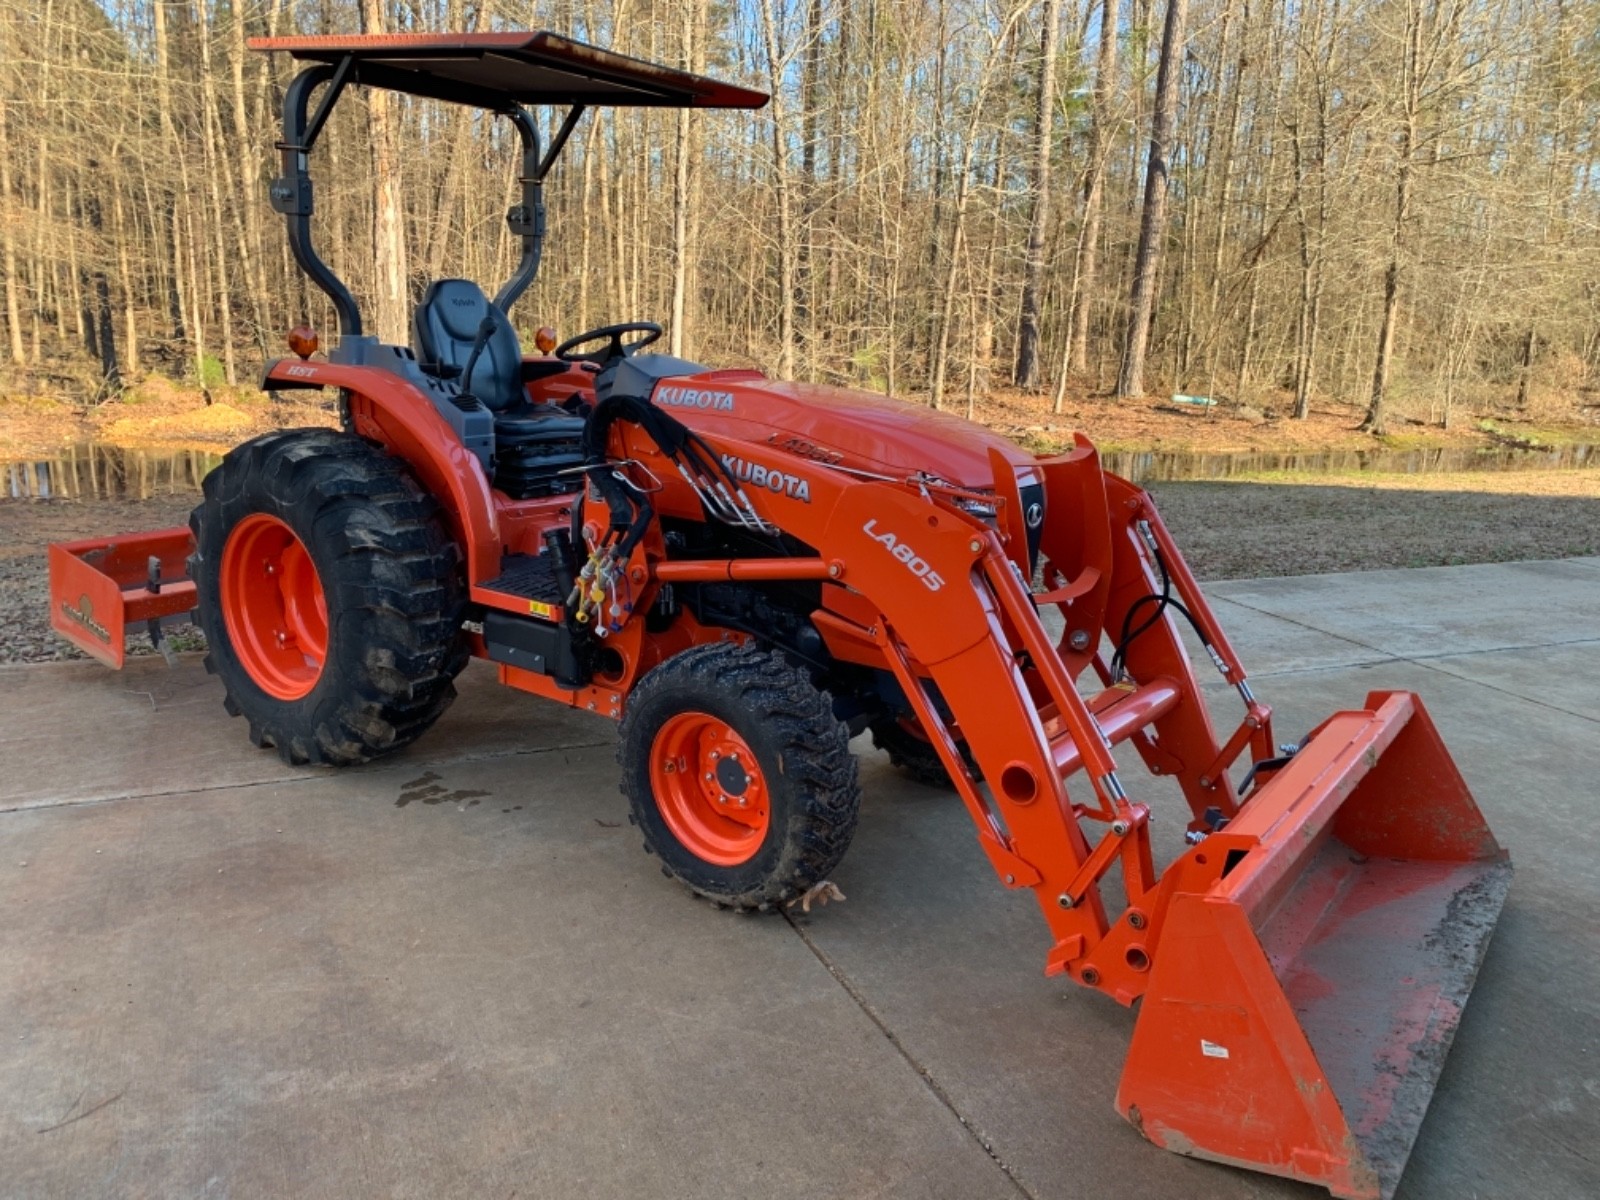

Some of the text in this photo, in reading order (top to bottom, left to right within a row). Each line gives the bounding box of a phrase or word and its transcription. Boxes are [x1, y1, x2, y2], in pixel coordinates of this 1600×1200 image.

[656, 387, 734, 411] KUBOTA
[721, 453, 811, 503] KUBOTA
[863, 518, 946, 592] LA805
